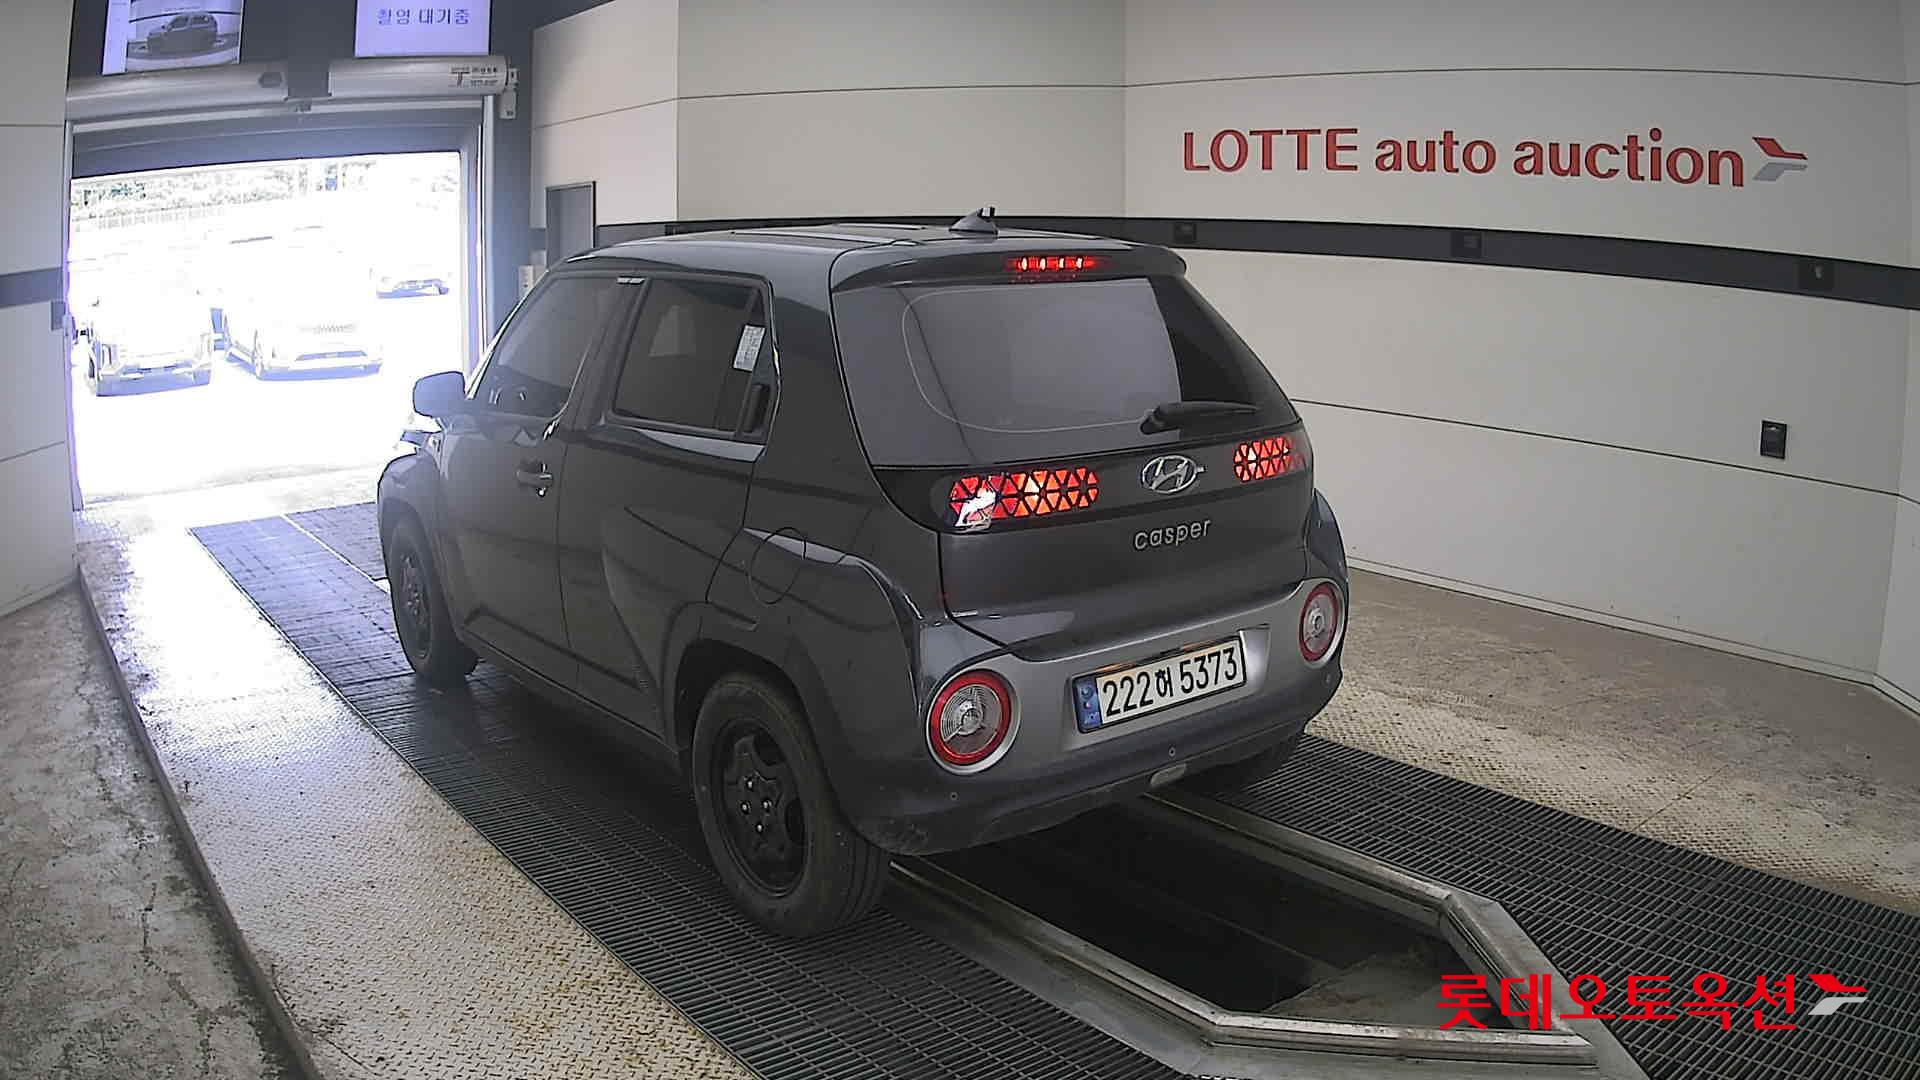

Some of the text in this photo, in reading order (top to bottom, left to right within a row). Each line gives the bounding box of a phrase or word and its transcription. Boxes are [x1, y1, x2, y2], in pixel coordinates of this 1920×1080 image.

[419, 8, 469, 25] 대기중
[1184, 128, 1744, 187] LOTTE auto auction
[1134, 519, 1211, 550] casper
[1179, 648, 1237, 694] 5373
